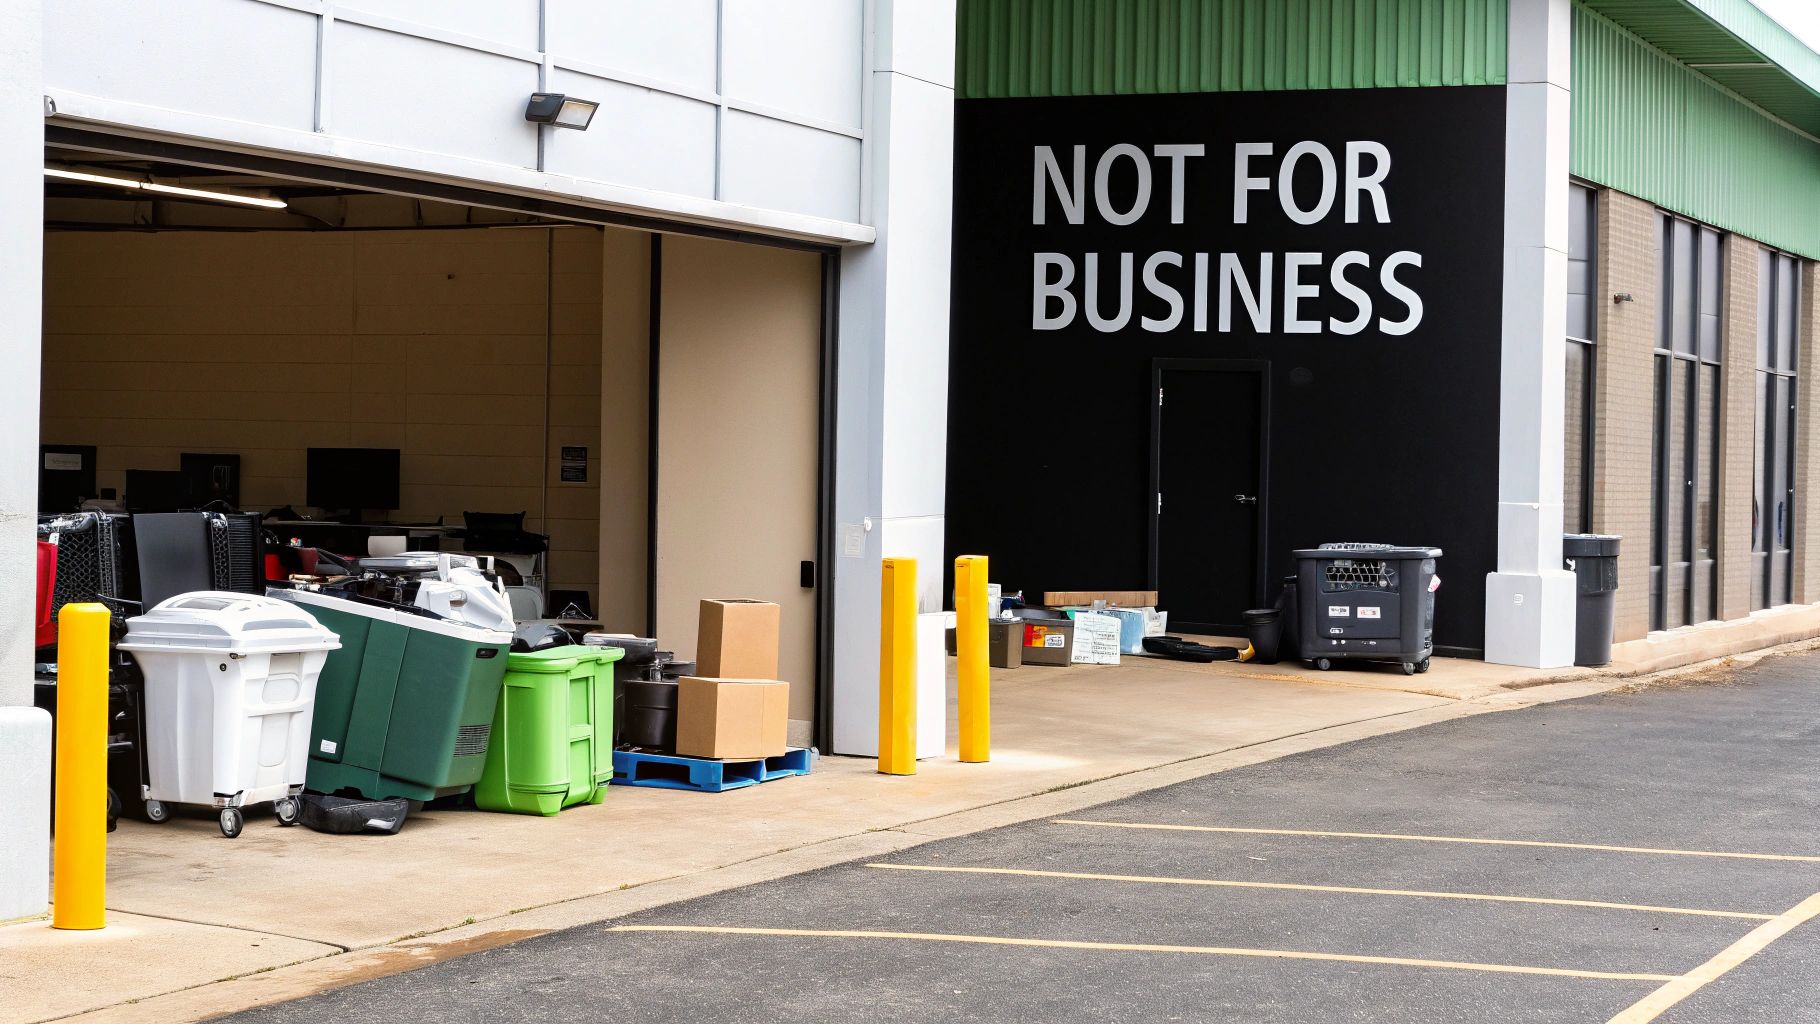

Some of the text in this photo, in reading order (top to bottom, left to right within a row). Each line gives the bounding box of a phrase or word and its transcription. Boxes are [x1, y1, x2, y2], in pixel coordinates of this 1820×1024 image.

[1032, 140, 1391, 225] NOT FOR
[1032, 250, 1424, 335] BUSINESS
